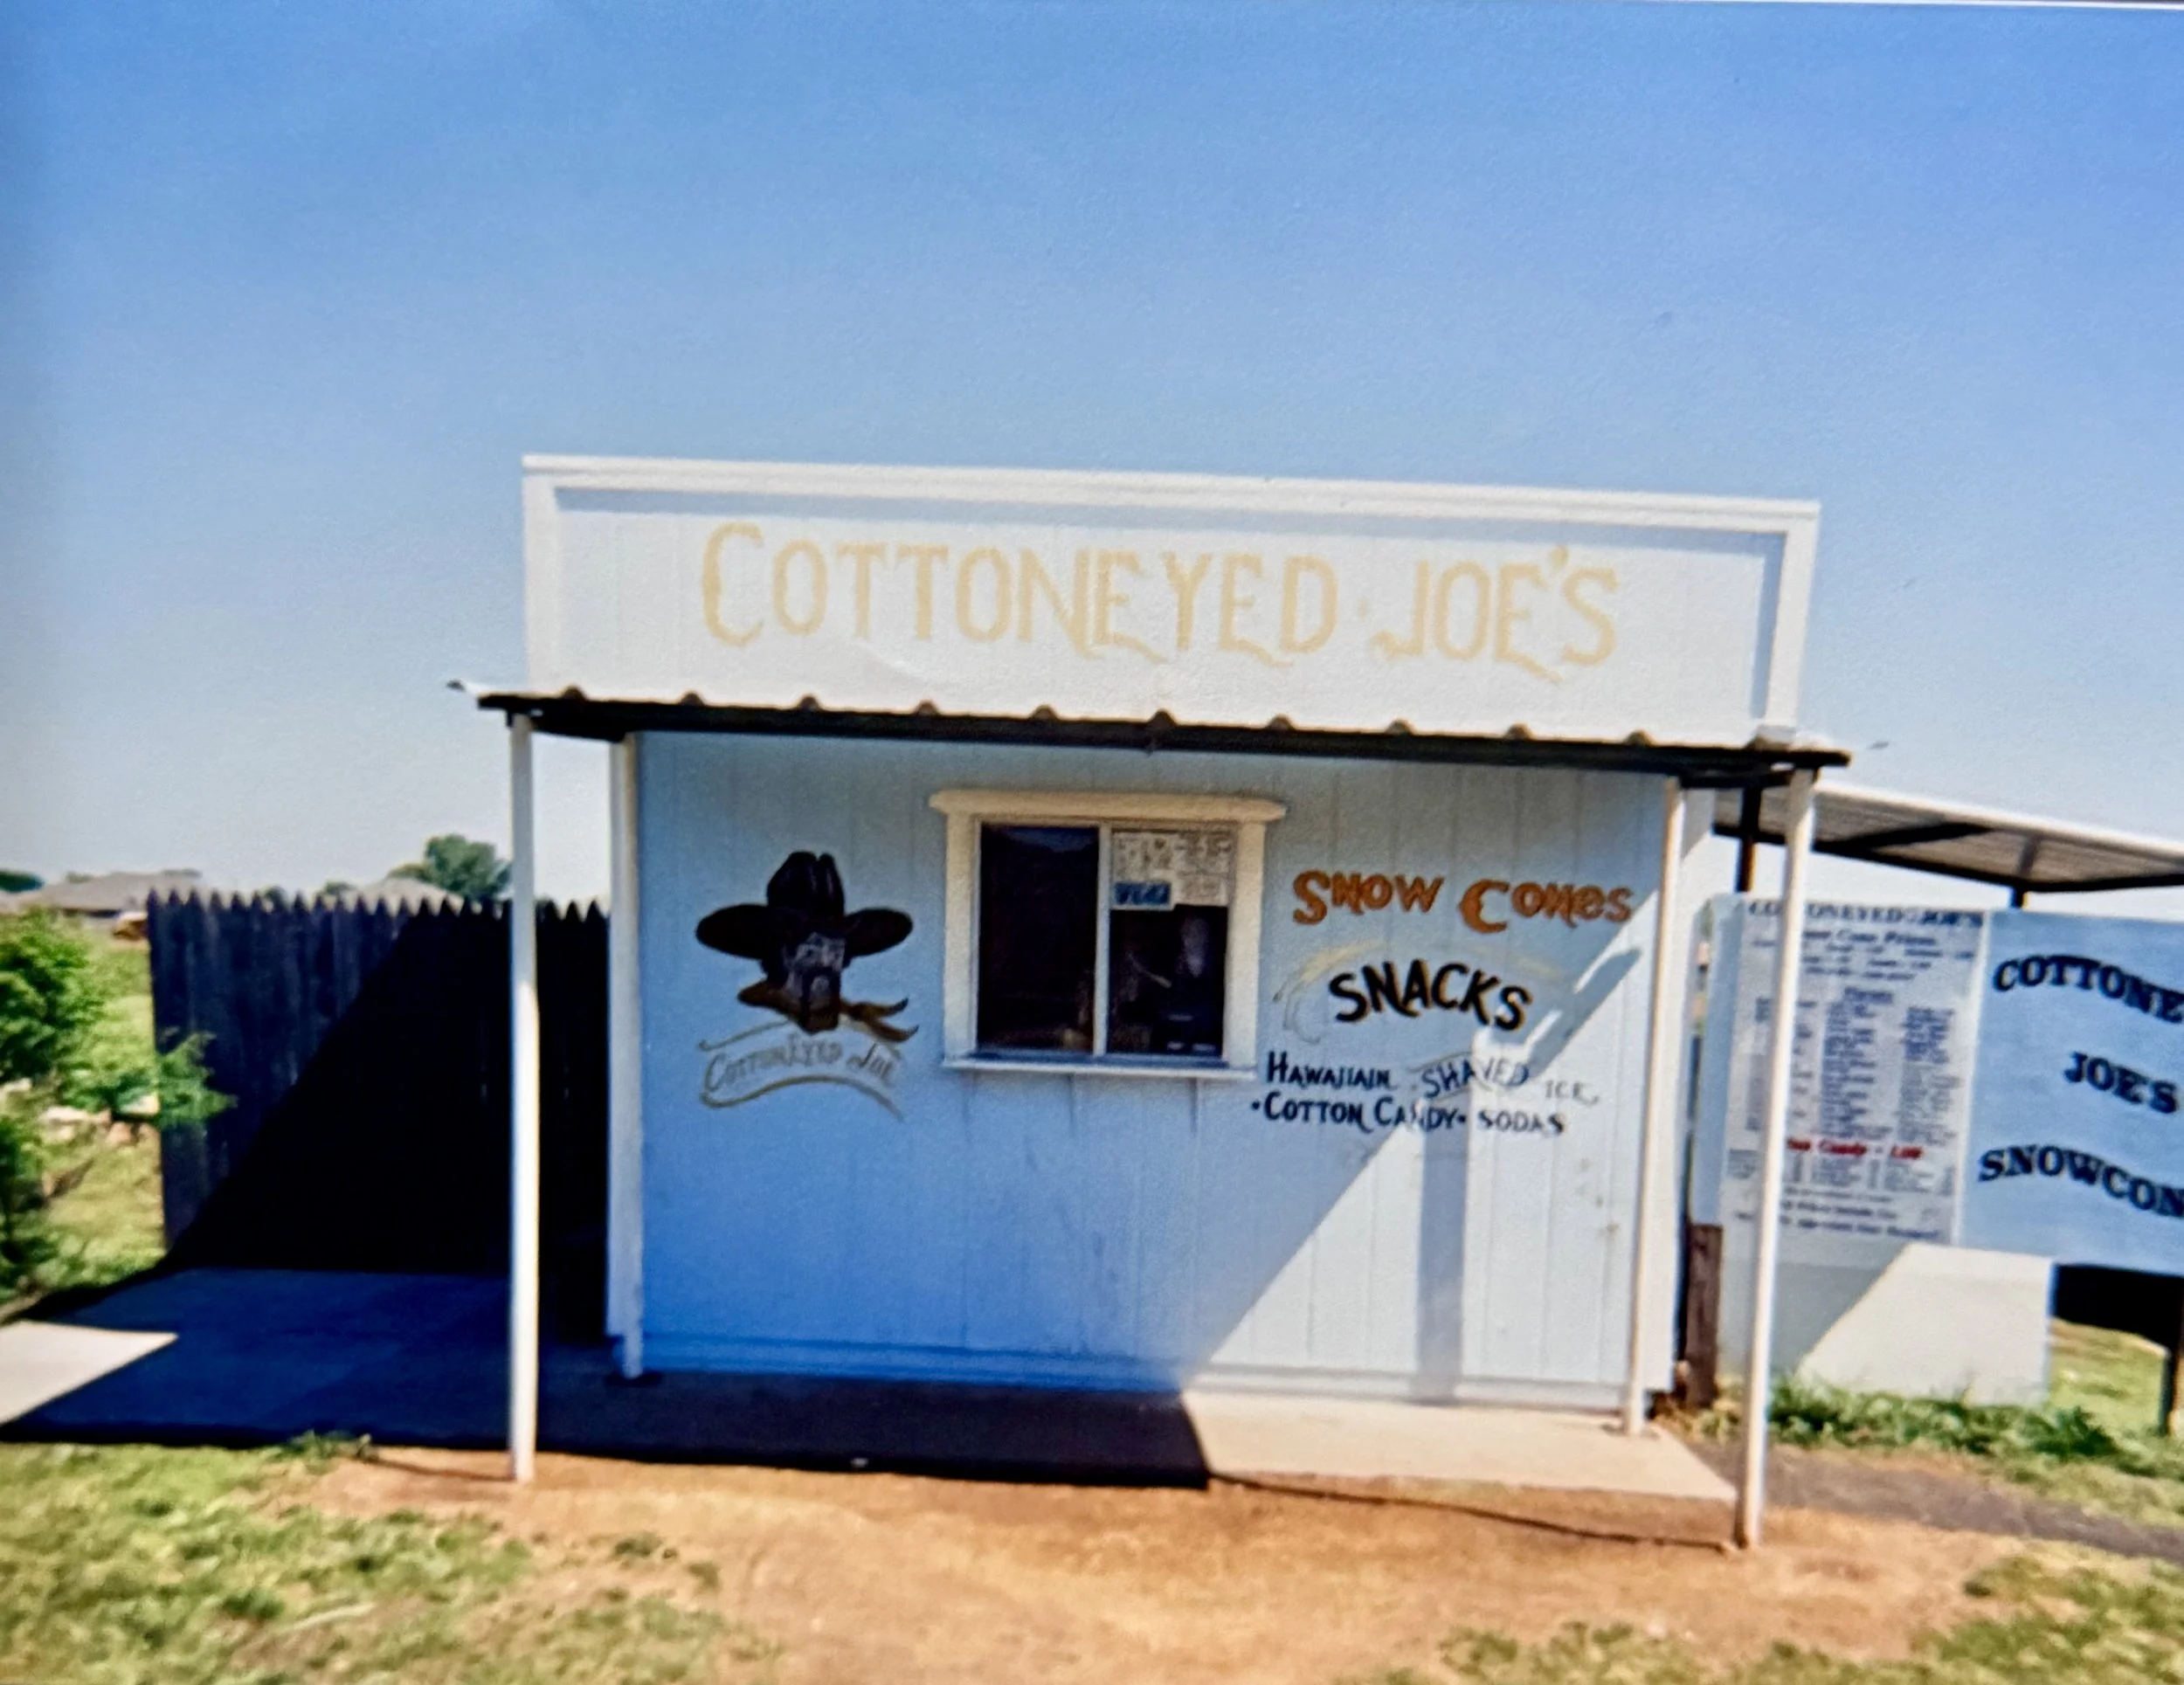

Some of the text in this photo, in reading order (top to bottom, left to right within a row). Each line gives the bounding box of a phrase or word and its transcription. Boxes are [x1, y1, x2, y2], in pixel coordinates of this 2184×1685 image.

[702, 521, 1619, 684] COTTONEYED JOE'S
[1292, 869, 1446, 926] SNOW
[1328, 958, 1533, 1032] SNACKS
[1421, 1057, 1531, 1099] SHAVED
[1476, 1107, 1565, 1136] SODAS
